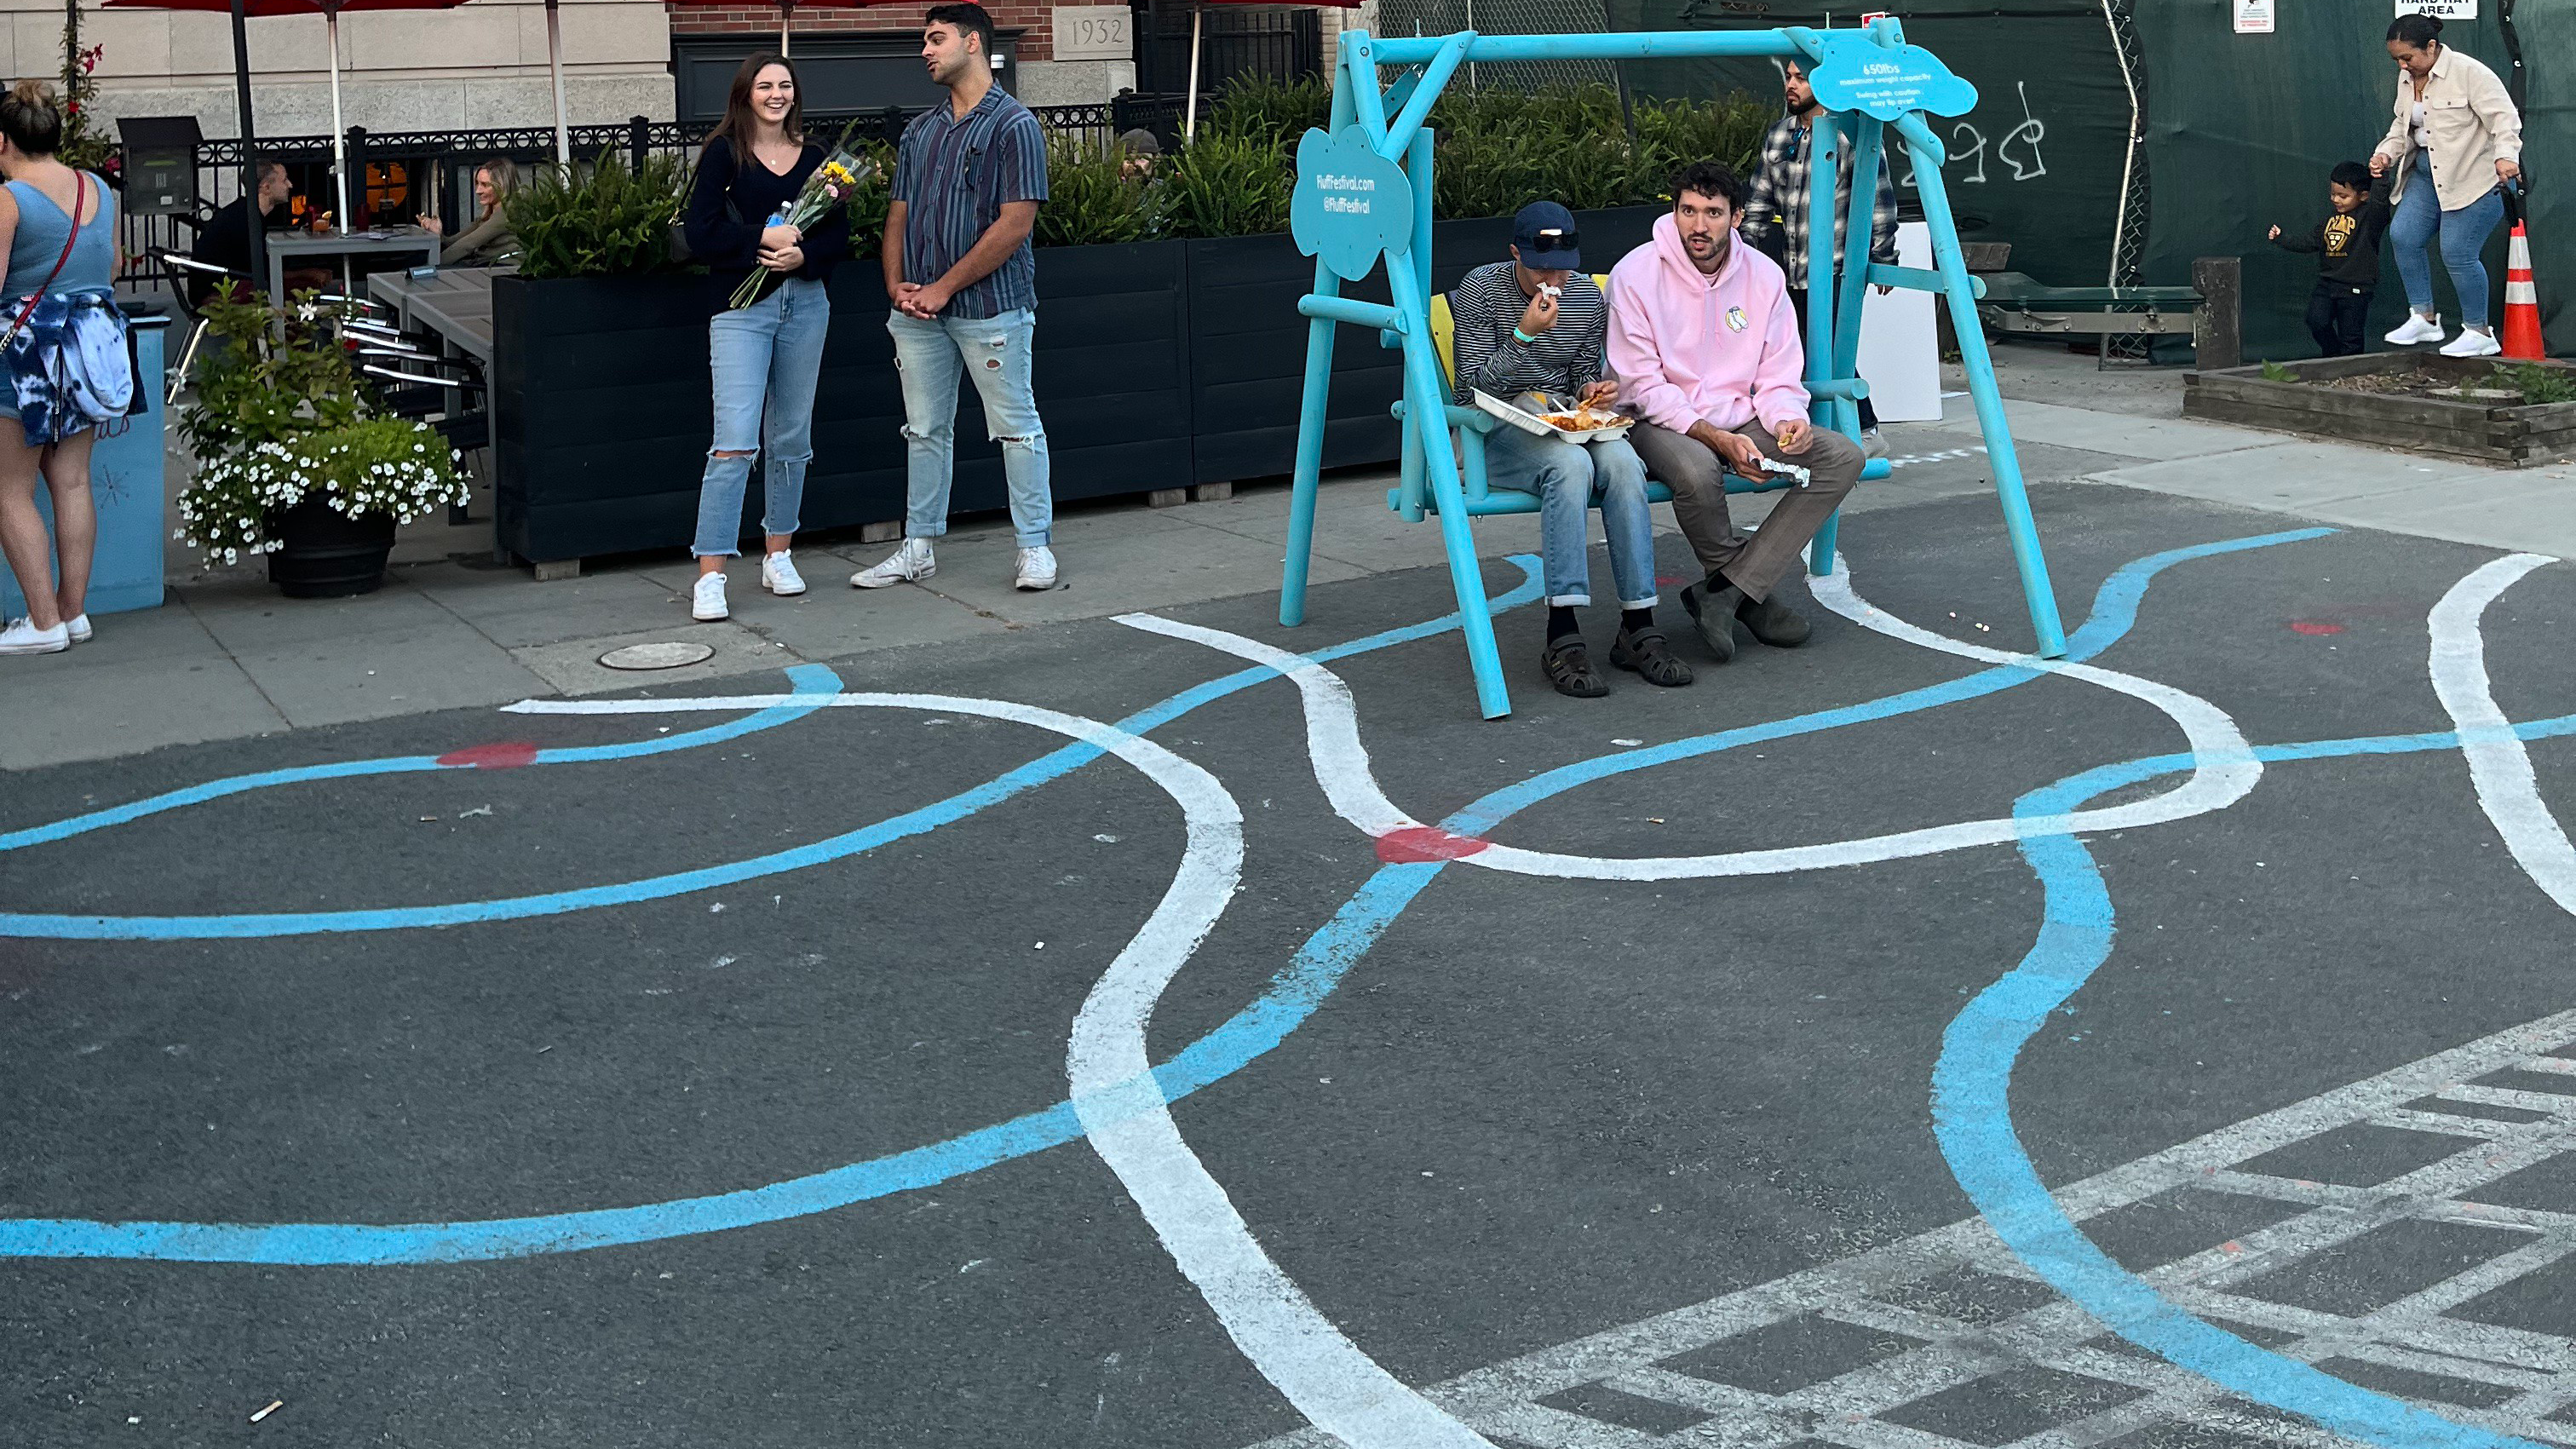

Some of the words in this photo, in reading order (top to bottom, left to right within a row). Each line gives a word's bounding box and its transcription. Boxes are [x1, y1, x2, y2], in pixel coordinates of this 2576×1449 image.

[2418, 5, 2455, 14] AREA
[1073, 19, 1124, 45] 1932
[1863, 63, 1900, 74] 650lbs
[1875, 76, 1899, 84] weight
[1899, 73, 1931, 82] capacity
